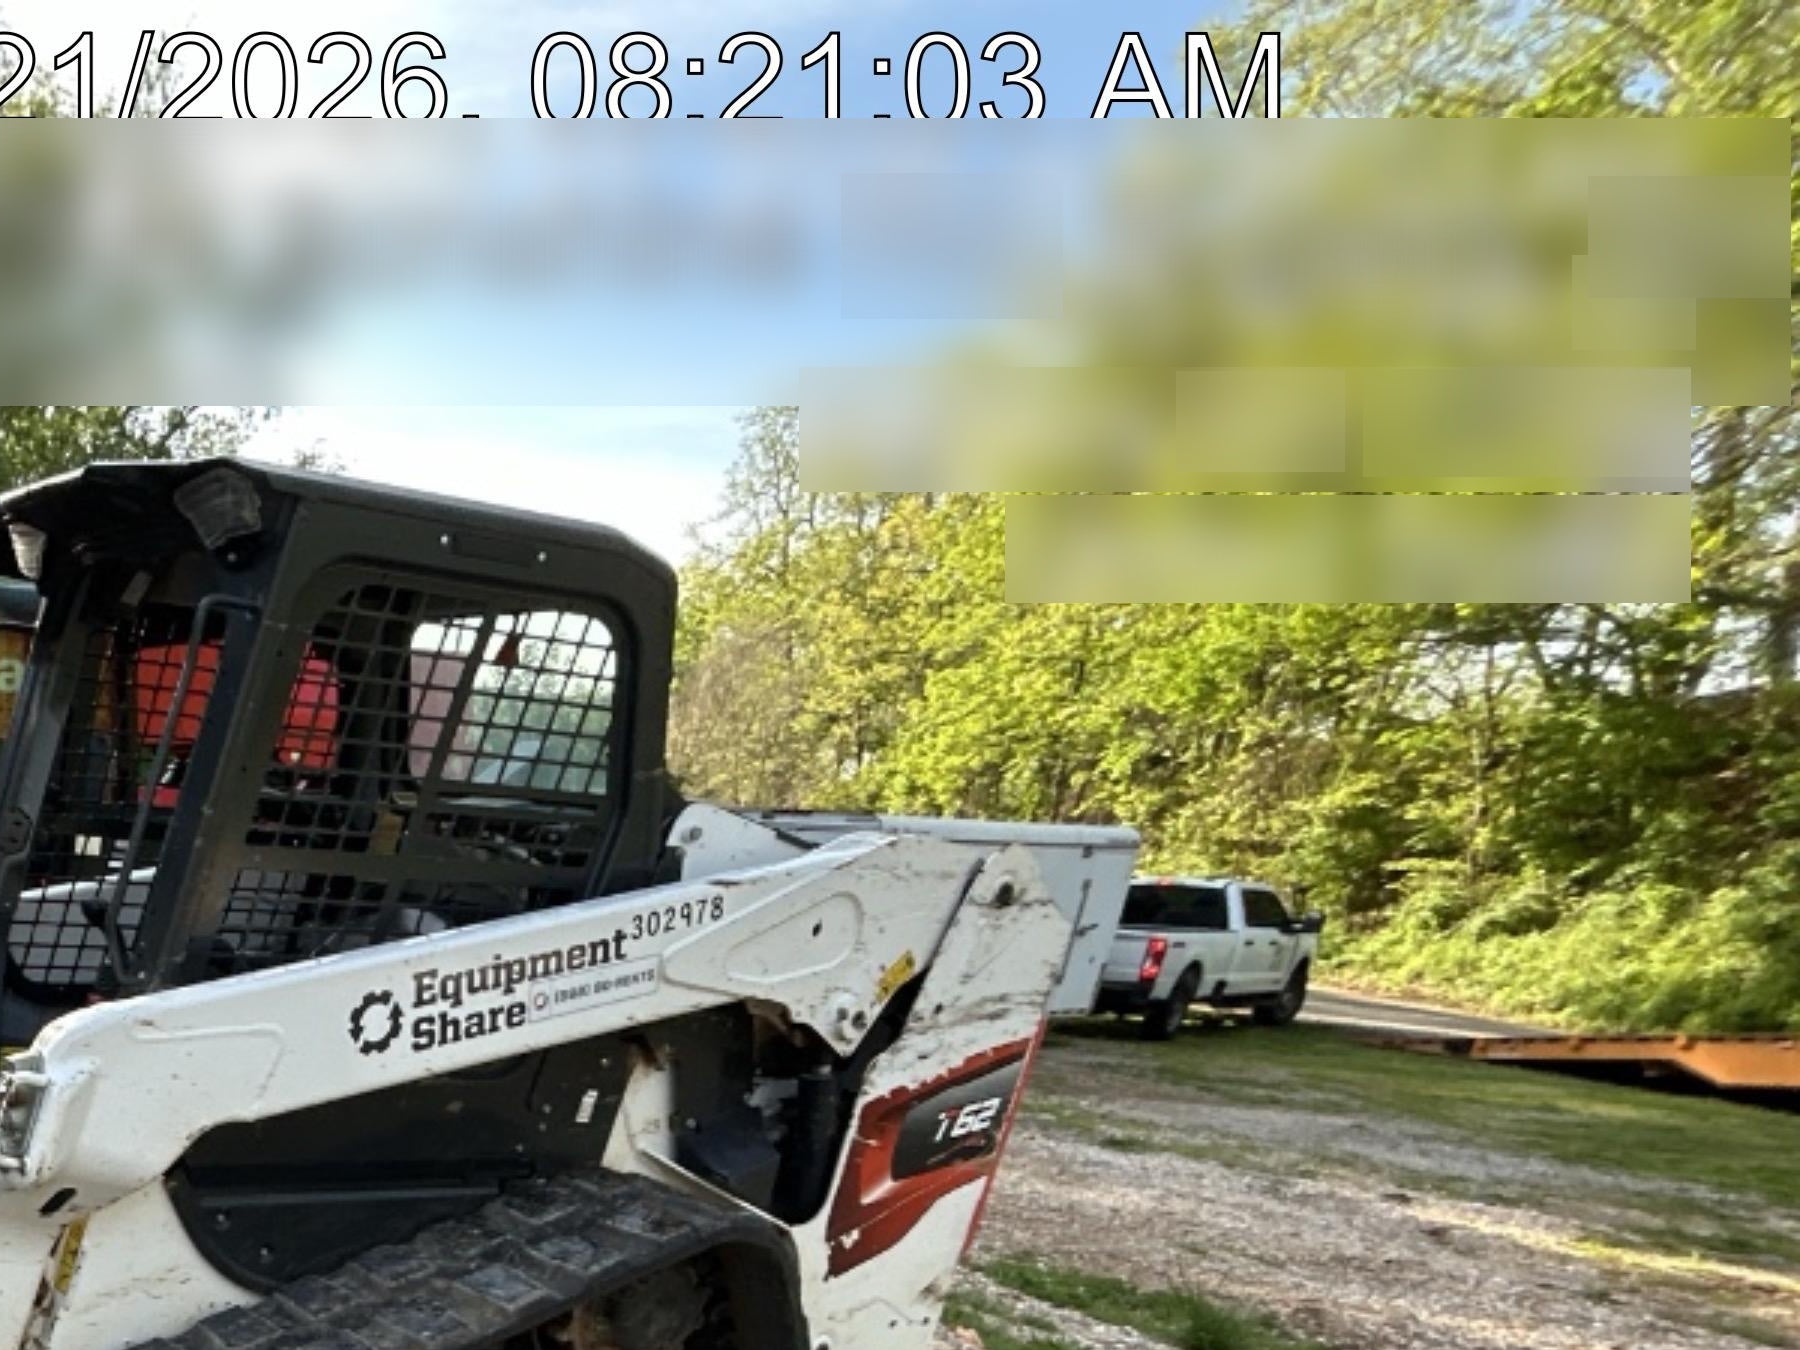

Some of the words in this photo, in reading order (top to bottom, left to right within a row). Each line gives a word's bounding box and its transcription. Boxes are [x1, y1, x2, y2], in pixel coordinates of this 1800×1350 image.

[631, 895, 724, 940] 302978
[412, 928, 628, 1009] Equipment
[411, 1000, 526, 1051] Share
